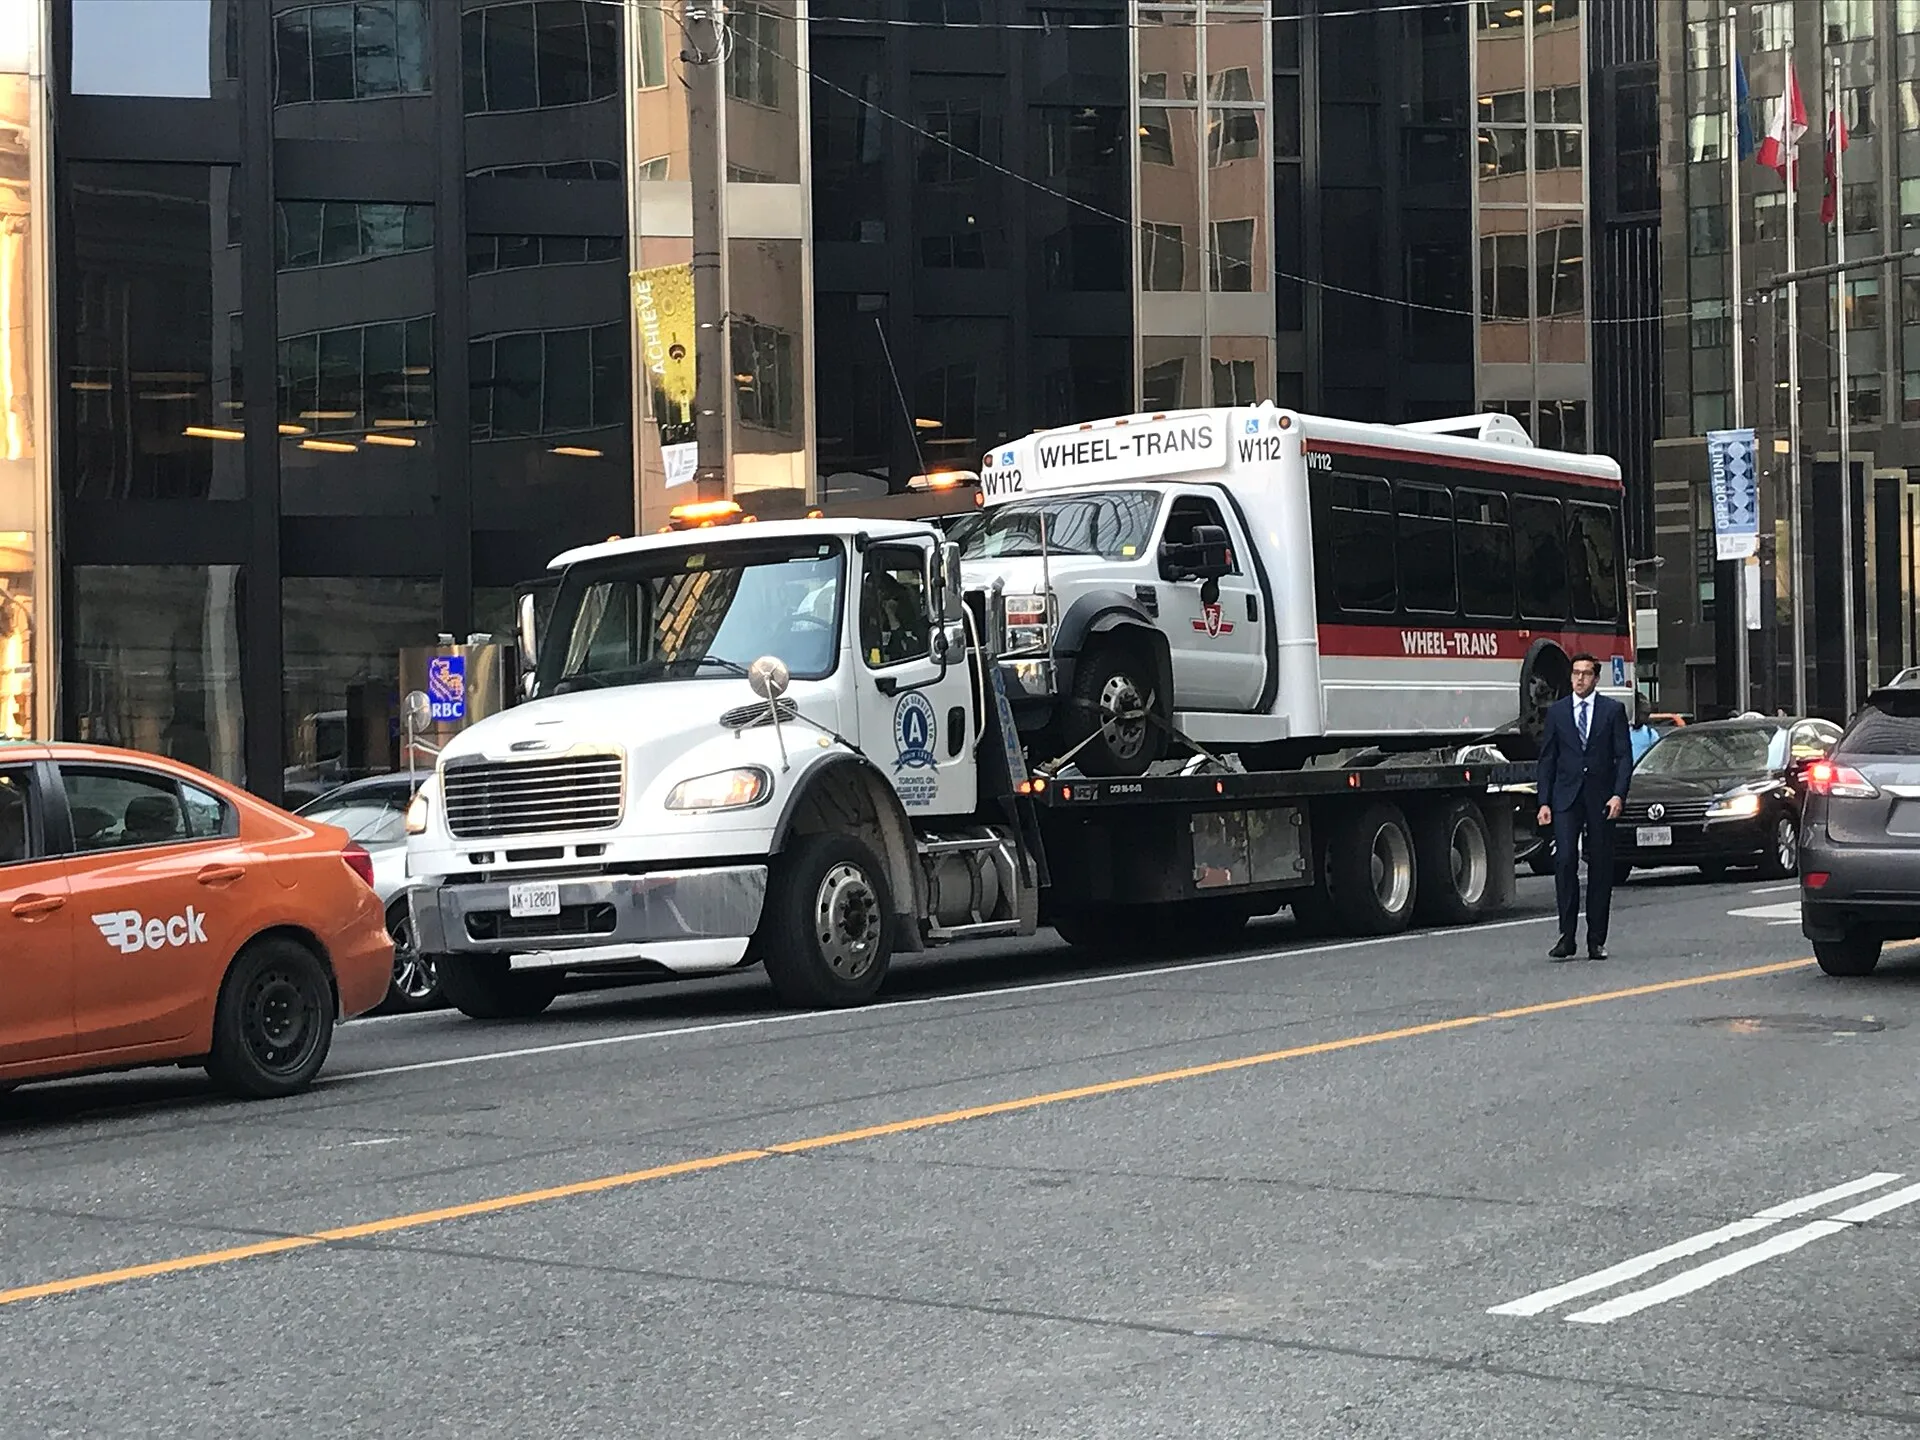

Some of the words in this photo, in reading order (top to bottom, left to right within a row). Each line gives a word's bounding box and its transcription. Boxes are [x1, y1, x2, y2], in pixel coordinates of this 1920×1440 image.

[636, 281, 666, 374] ACHIEVE
[1040, 426, 1214, 469] WHEEL-TRANS
[1238, 436, 1281, 463] W112
[1307, 452, 1332, 471] W112
[984, 469, 1023, 496] W112
[1711, 439, 1730, 529] OPPORTUNITY
[1401, 631, 1498, 656] WHEEL-TRANS
[432, 702, 463, 718] RBC
[909, 711, 923, 743] A
[91, 904, 208, 954] Beck
